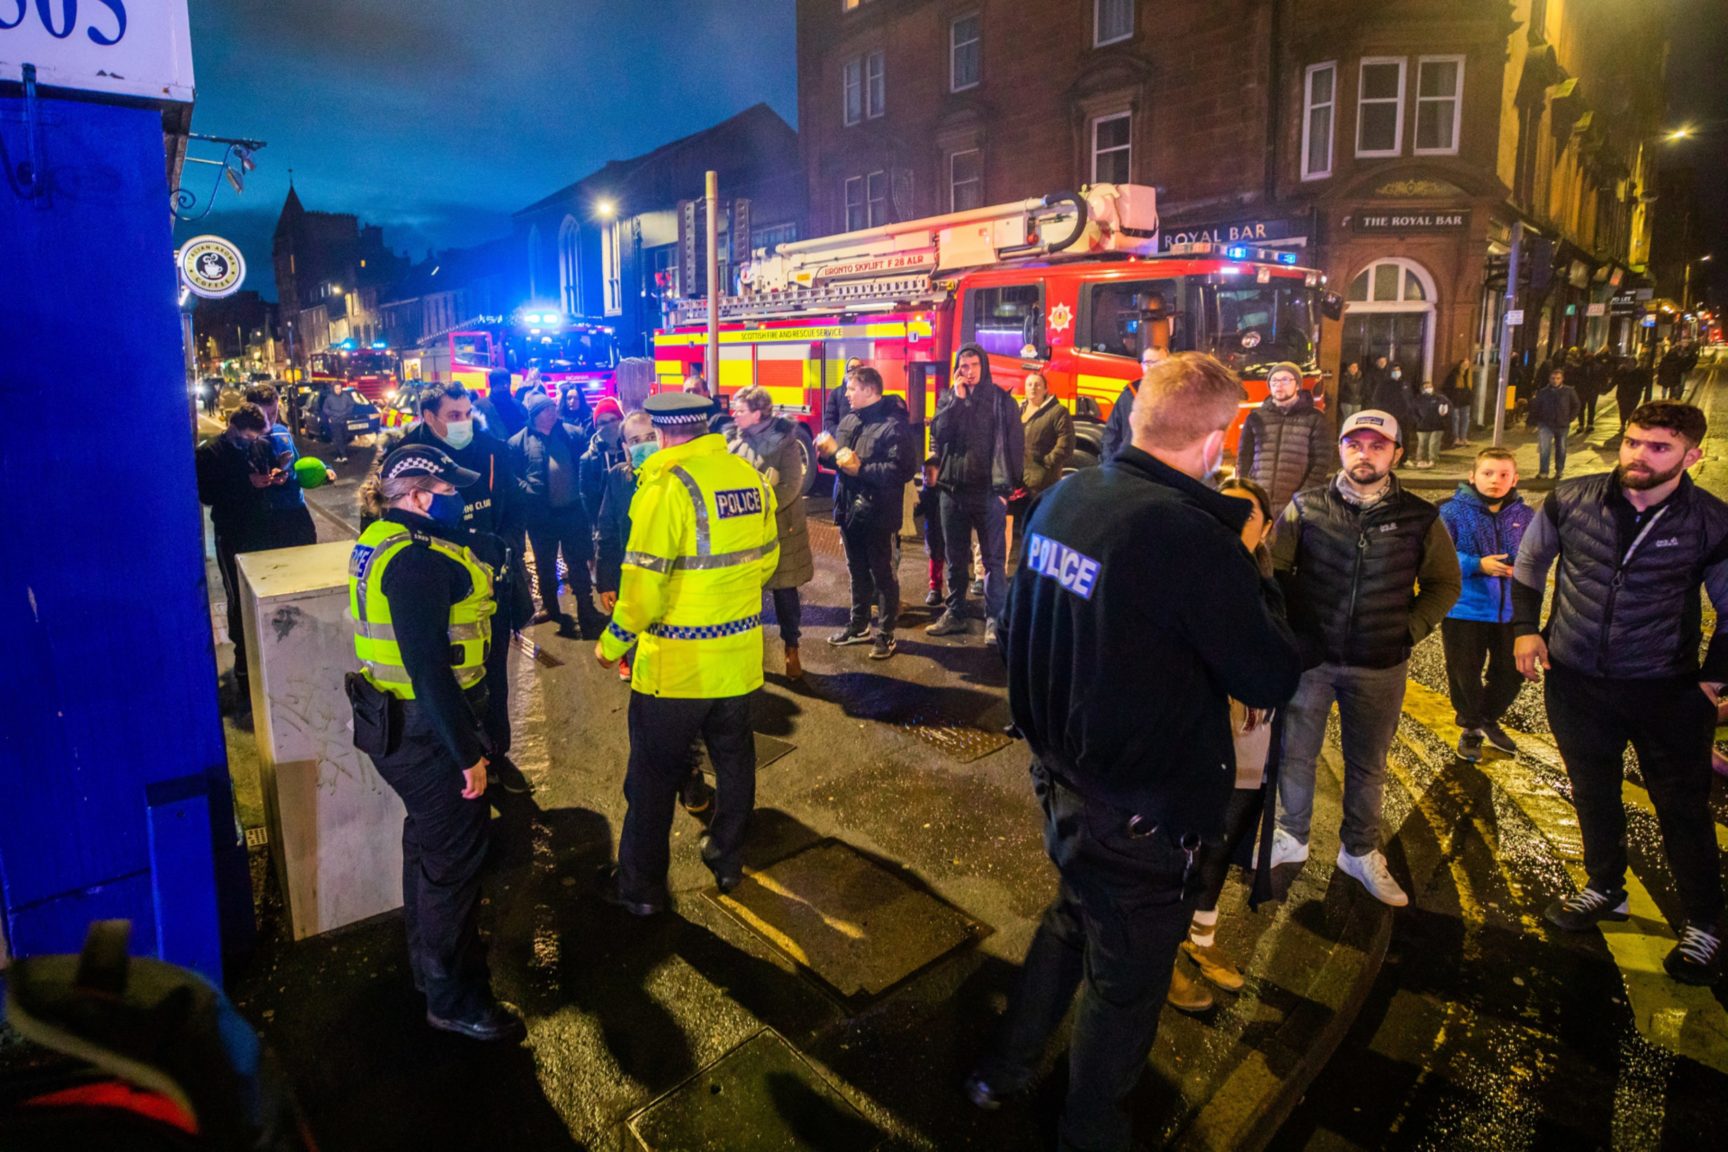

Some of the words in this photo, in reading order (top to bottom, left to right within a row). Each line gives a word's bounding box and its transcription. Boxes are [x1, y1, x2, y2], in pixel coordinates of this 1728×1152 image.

[1363, 217, 1388, 227] THE
[1391, 216, 1432, 227] ROYAL
[1435, 215, 1463, 226] BAR
[1164, 228, 1222, 248] ROYAL
[1229, 223, 1267, 241] BAR
[855, 261, 884, 272] SKYLIFT
[887, 258, 893, 268] F
[894, 257, 905, 267] 28
[907, 255, 924, 265] ALR
[195, 276, 231, 288] COFFEE
[741, 331, 766, 341] SCOTTISH
[766, 331, 778, 340] FIRE
[779, 331, 792, 339] AND
[792, 329, 815, 339] RESCUE
[816, 328, 842, 337] SERVICE
[717, 491, 761, 515] POLICE
[1028, 535, 1097, 595] POLICE
